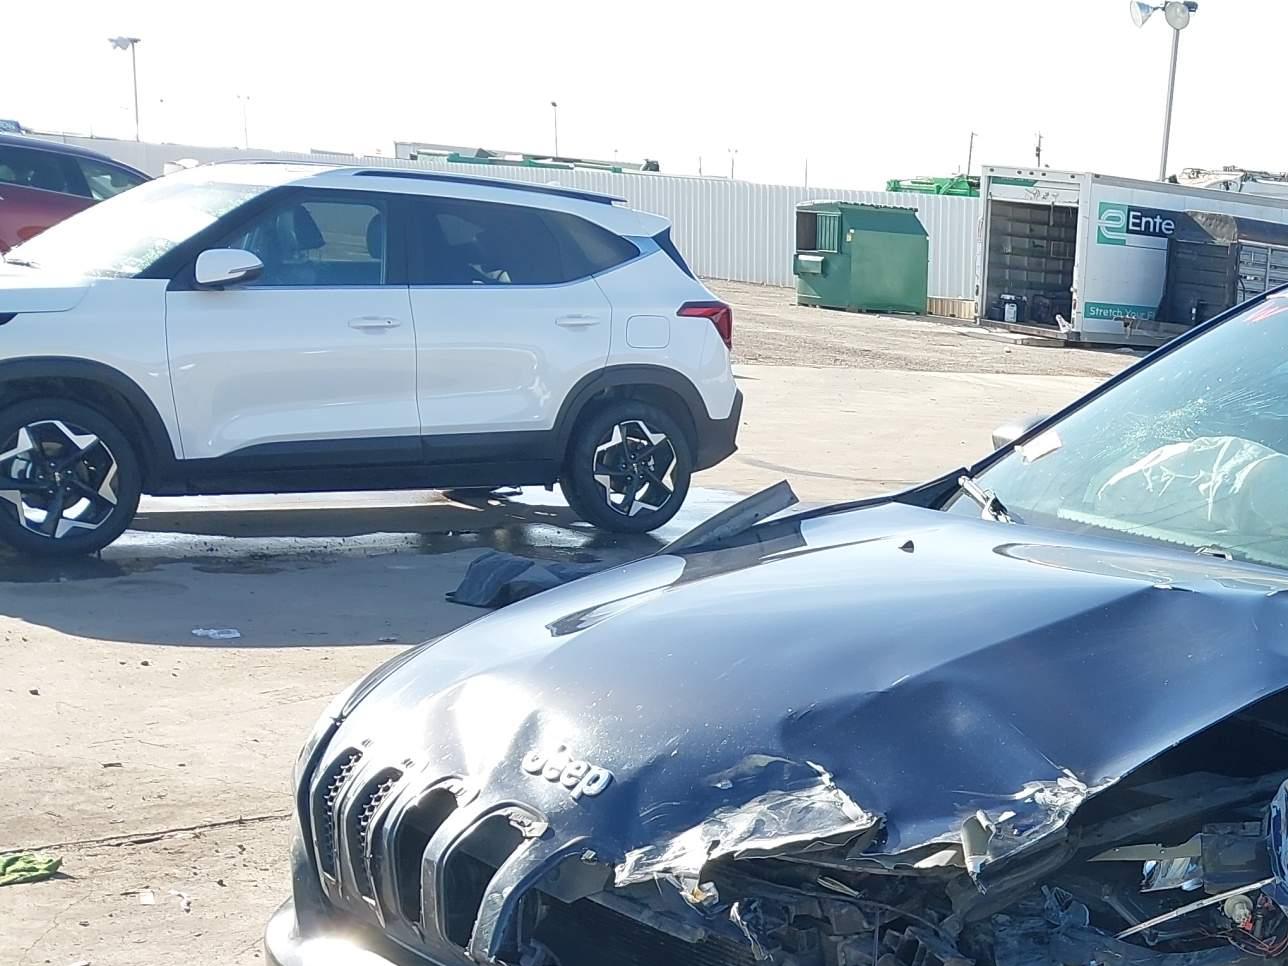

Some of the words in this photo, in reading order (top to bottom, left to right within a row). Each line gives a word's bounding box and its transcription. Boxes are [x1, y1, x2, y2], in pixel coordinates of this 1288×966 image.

[1128, 211, 1175, 234] Ente
[1090, 306, 1123, 318] Stretch
[521, 740, 616, 802] Jeep
